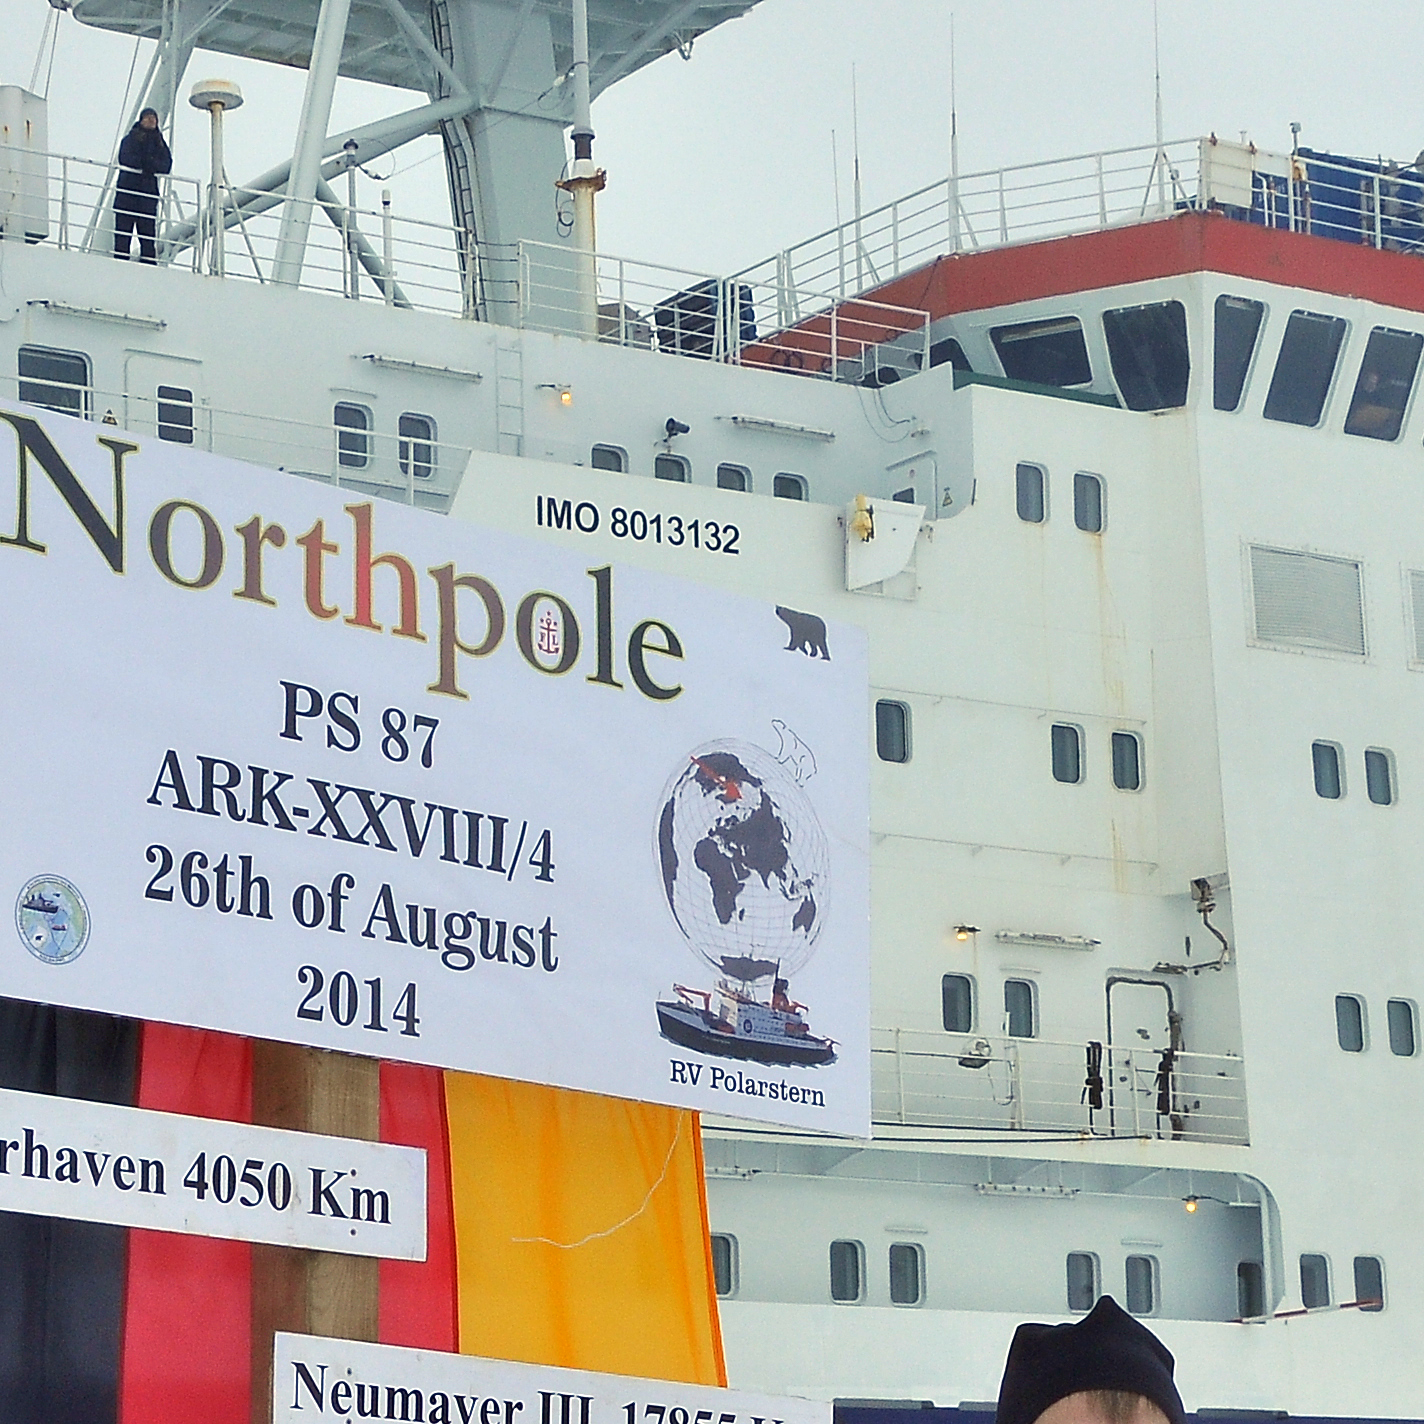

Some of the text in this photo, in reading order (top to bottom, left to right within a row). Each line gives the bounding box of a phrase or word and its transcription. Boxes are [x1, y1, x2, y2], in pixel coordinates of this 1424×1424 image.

[536, 495, 740, 555] IMO 8013132
[279, 680, 440, 768] PS 87
[146, 749, 556, 883] ARK-XXVIII/4
[144, 844, 273, 920] 26th
[292, 873, 355, 933] of
[361, 882, 559, 972] August
[296, 965, 421, 1037] 2014
[669, 1059, 826, 1108] RV Polarstern
[183, 1146, 292, 1213] 4050
[309, 1165, 392, 1224] Km
